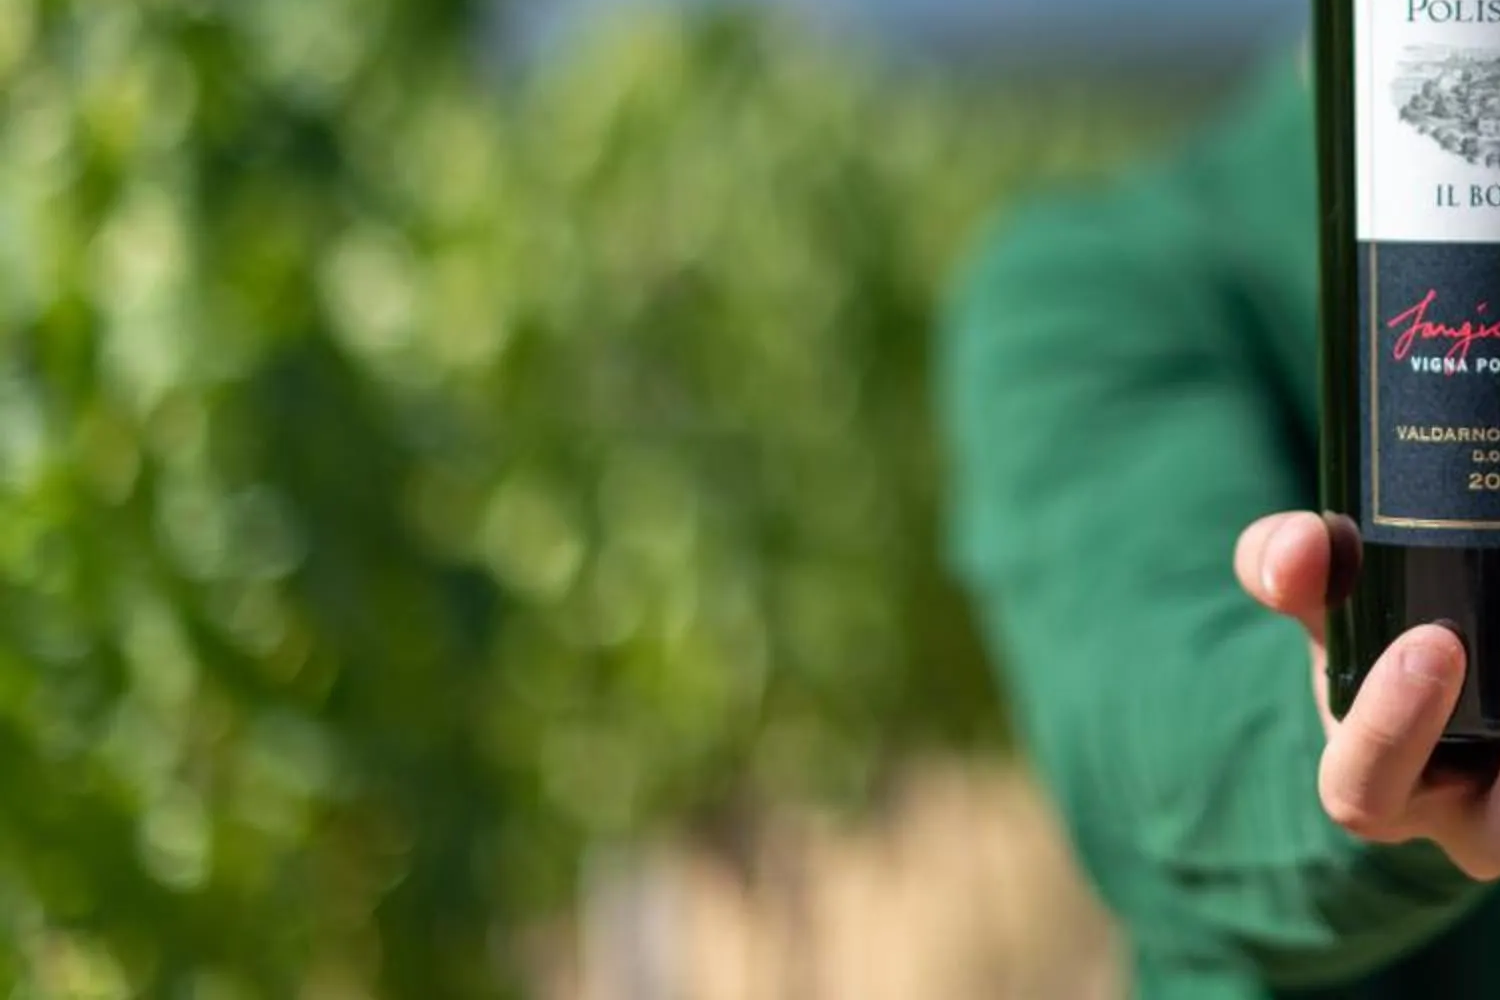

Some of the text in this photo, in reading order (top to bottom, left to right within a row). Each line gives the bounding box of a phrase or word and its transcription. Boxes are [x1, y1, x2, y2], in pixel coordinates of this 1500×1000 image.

[1436, 184, 1460, 208] IL
[1411, 357, 1468, 373] VIGNA
[1396, 426, 1500, 442] VALDARNO
